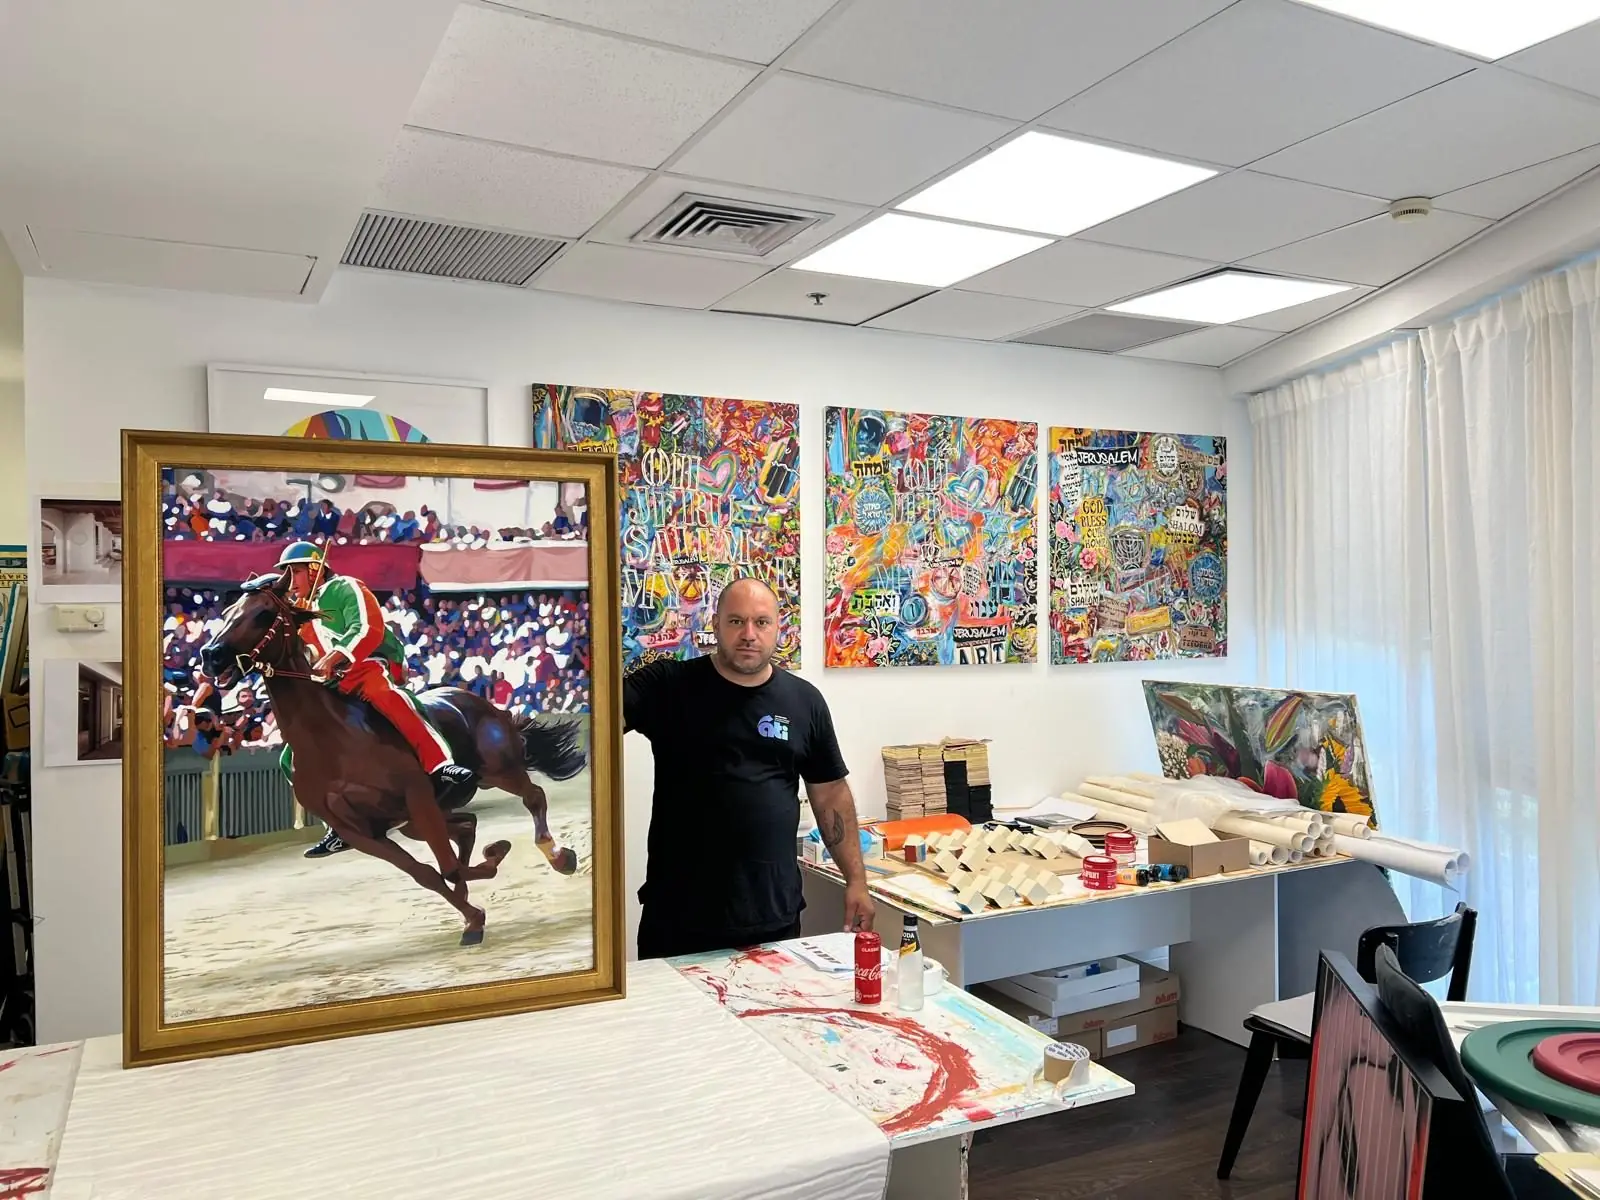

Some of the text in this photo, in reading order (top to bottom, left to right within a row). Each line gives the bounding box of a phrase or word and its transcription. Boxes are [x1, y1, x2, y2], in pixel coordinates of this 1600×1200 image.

[1078, 449, 1138, 465] JERUSALEM
[1083, 500, 1104, 514] GOD
[1081, 515, 1107, 528] BLESS
[1169, 520, 1203, 534] SHALOM
[1071, 596, 1098, 607] SHALOM
[954, 626, 1006, 639] JERUSALEM
[959, 643, 1005, 665] ART
